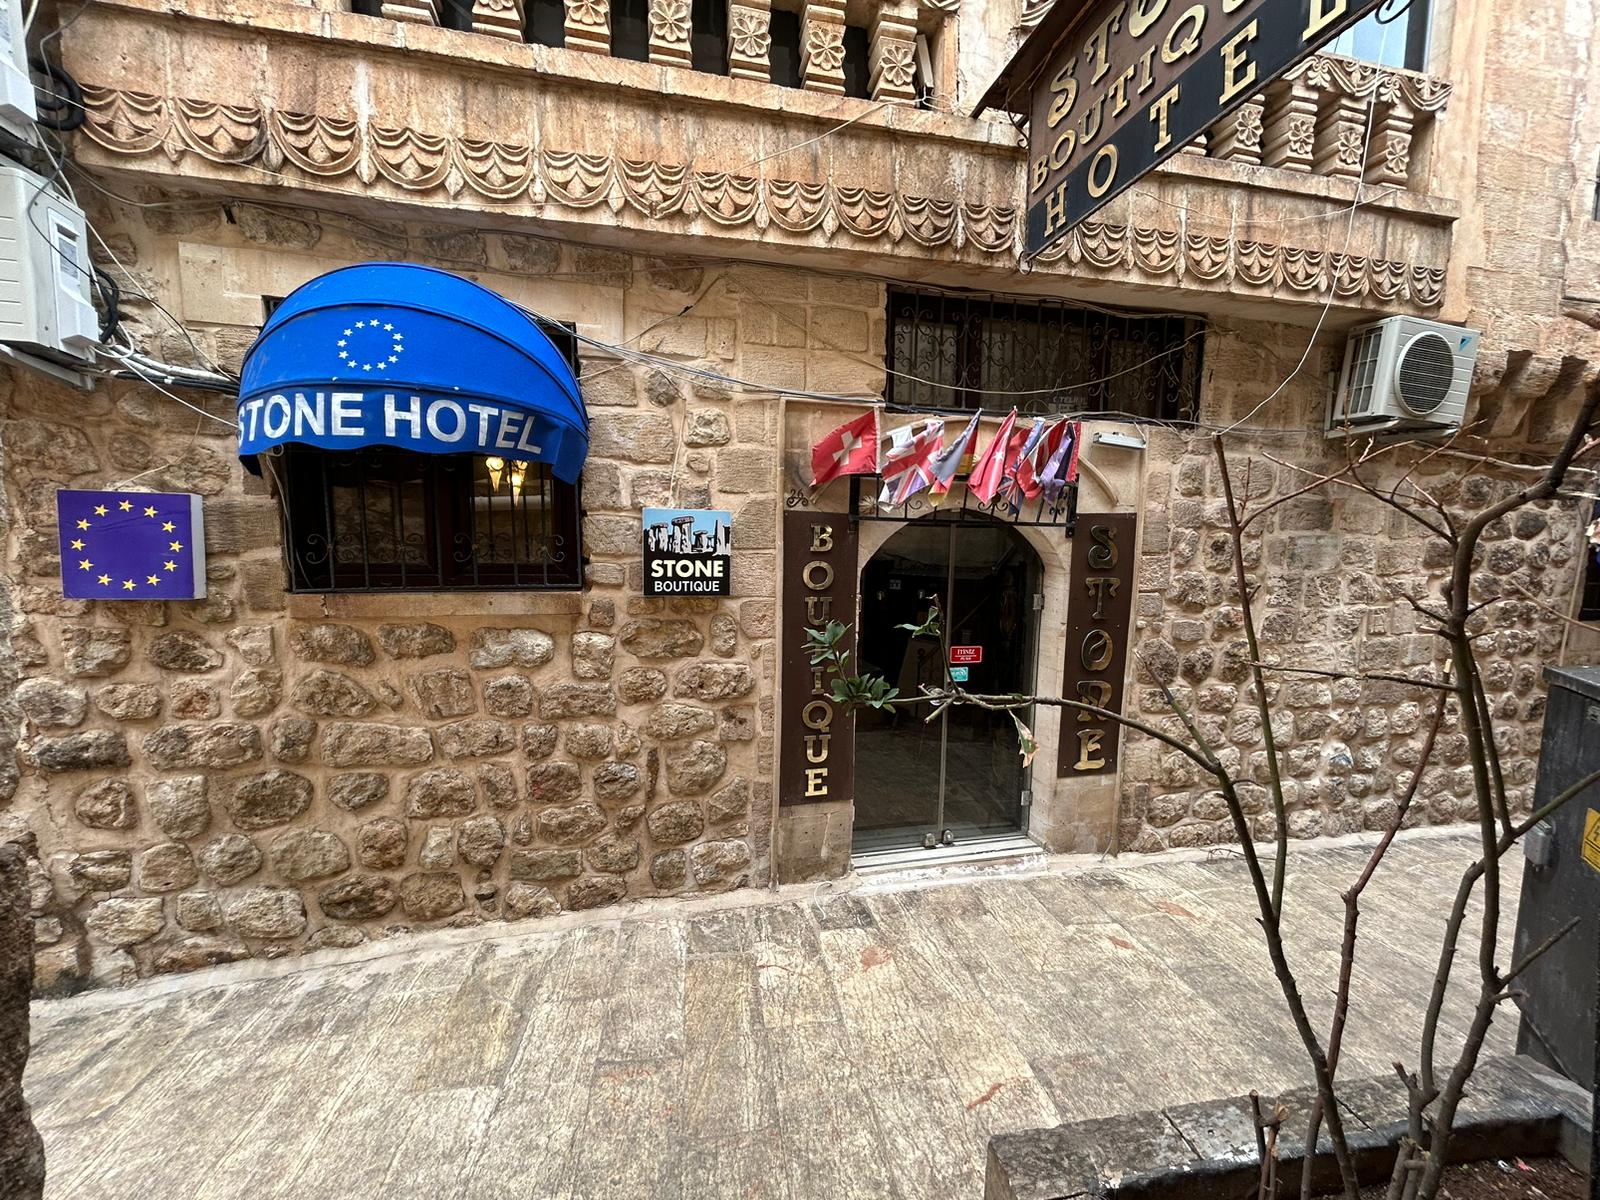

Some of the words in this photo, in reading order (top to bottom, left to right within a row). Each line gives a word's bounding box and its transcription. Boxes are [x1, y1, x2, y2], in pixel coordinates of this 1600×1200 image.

[1031, 0, 1247, 195] BOUTIQ
[1043, 0, 1347, 237] HOTEL
[238, 393, 364, 446] STONE
[384, 394, 542, 454] HOTEL
[651, 559, 724, 578] STONE
[654, 581, 720, 592] BOUTIQUE
